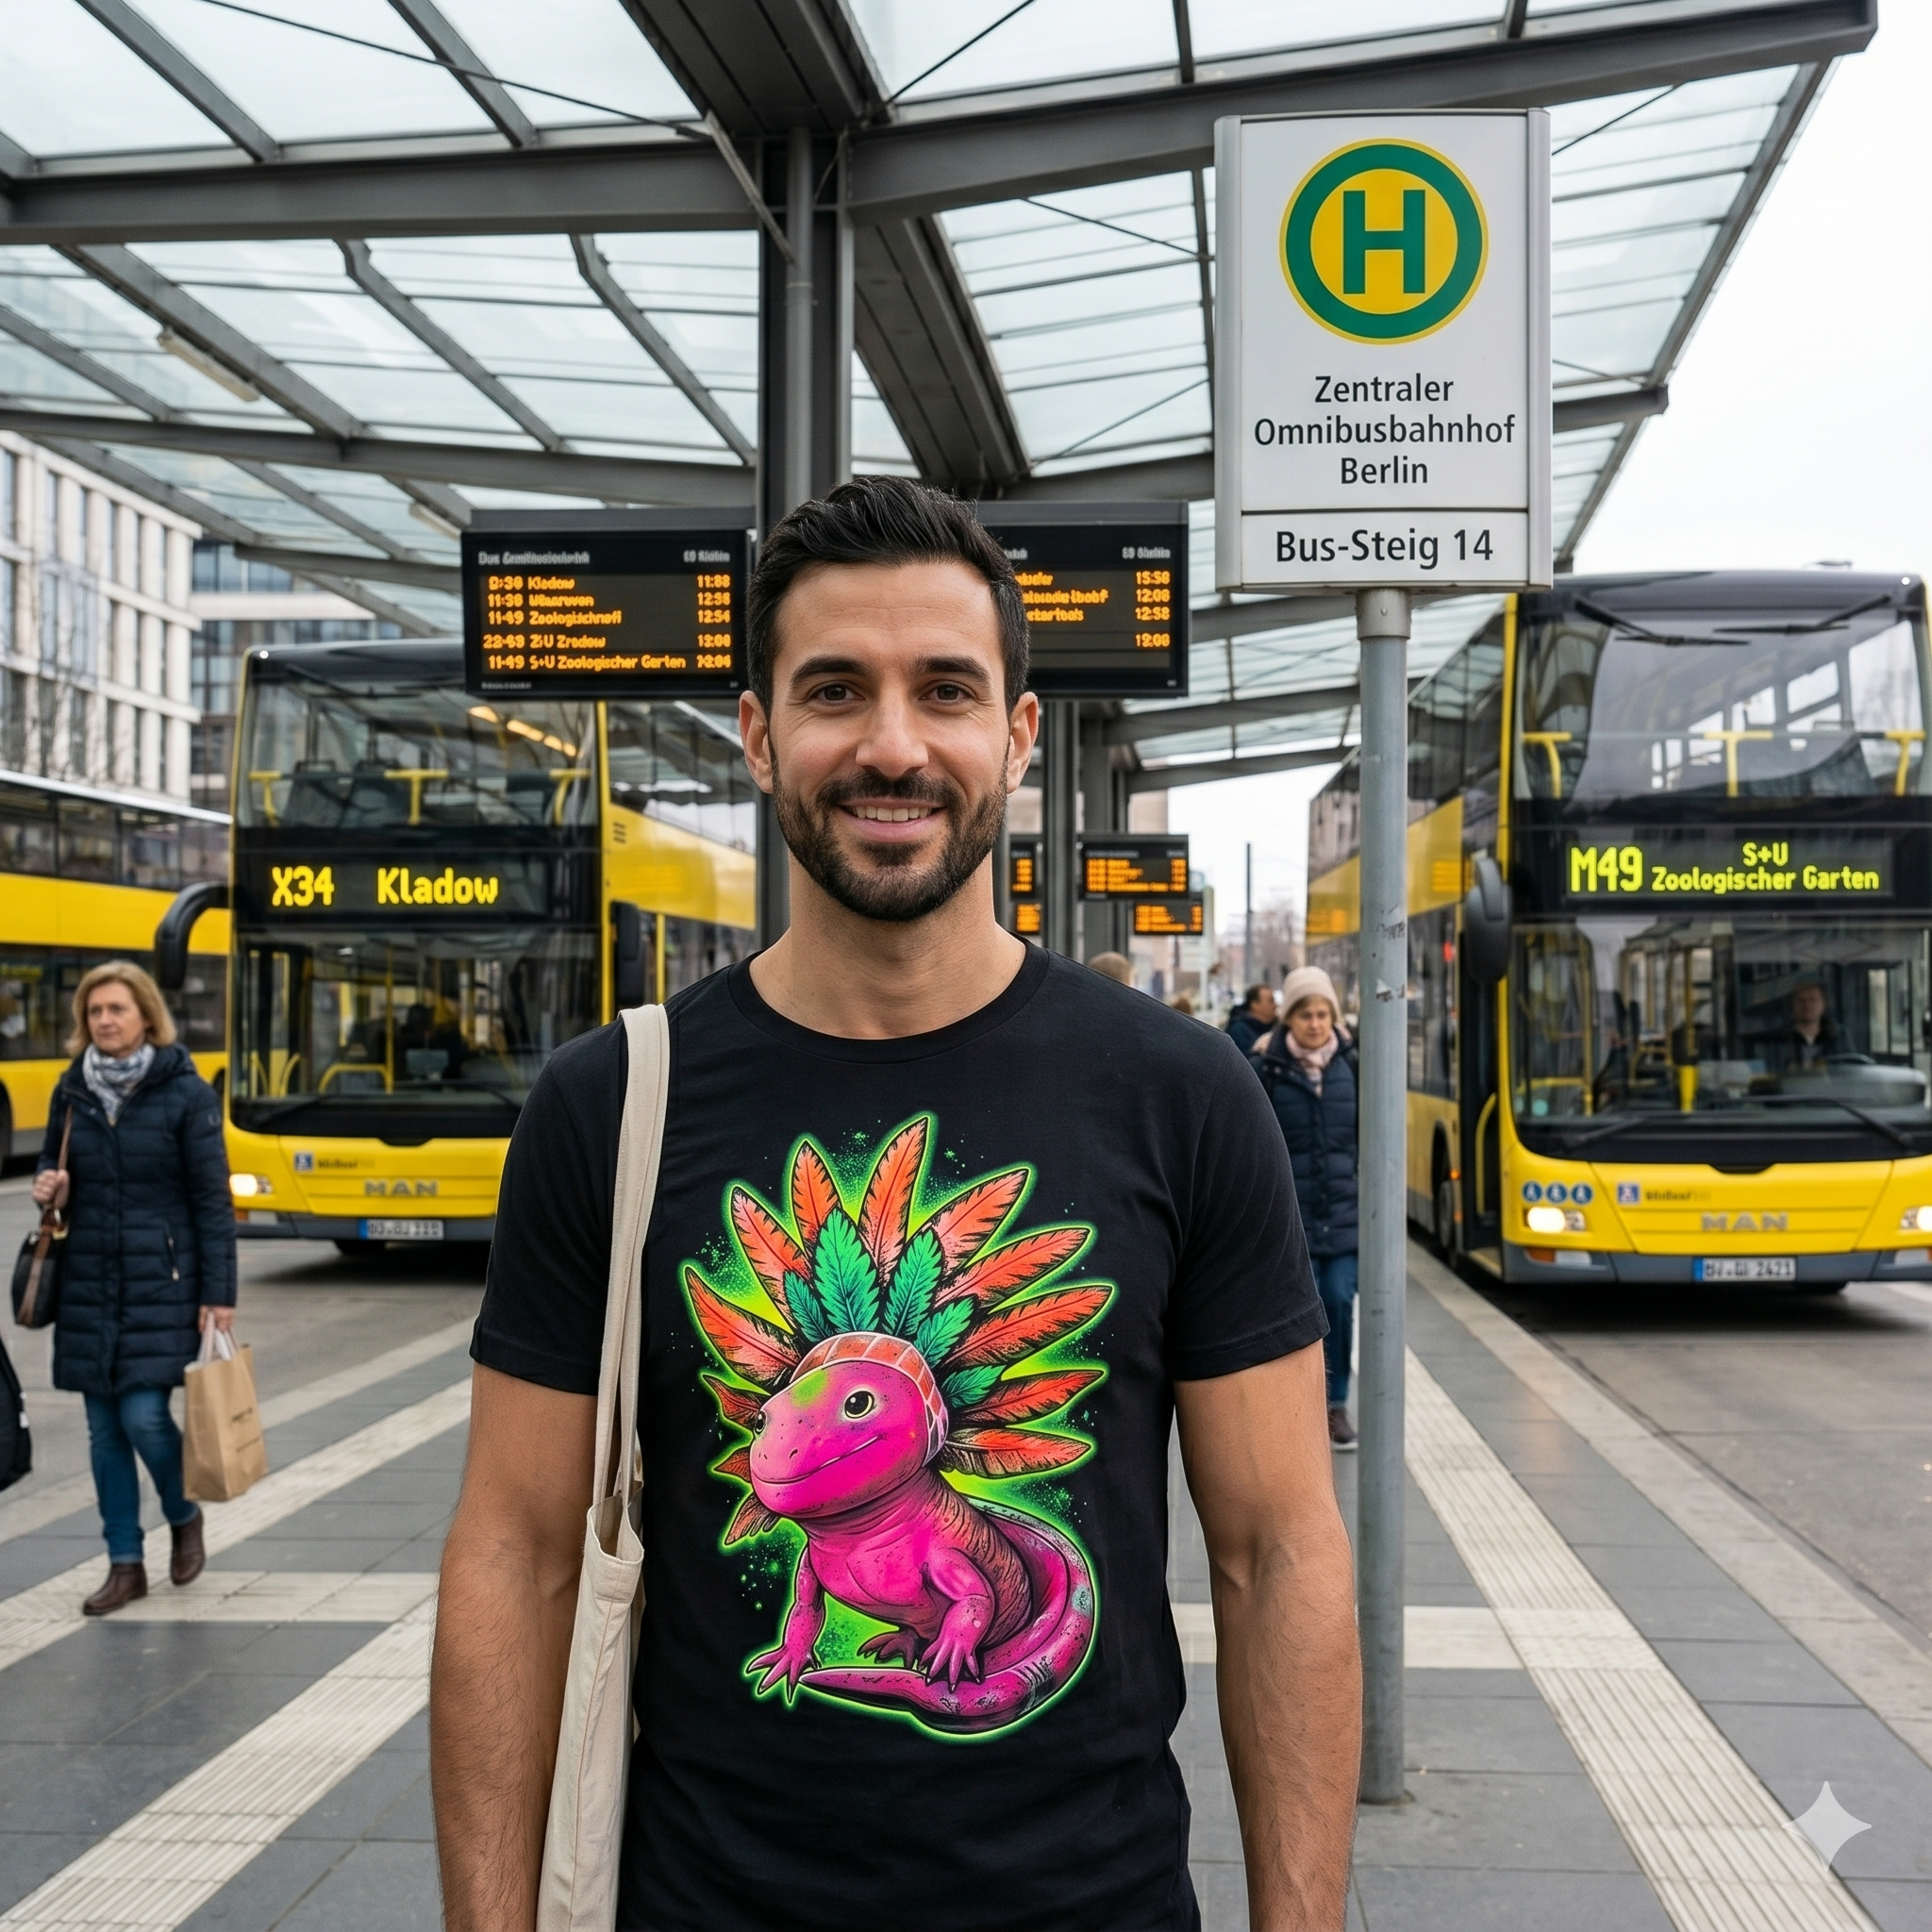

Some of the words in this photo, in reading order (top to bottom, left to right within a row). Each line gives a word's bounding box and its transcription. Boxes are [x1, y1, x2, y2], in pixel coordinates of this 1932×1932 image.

[1342, 189, 1426, 294] H
[1315, 374, 1453, 402] Zentraler
[1256, 414, 1515, 445] Omnibusbahnhof
[1341, 456, 1426, 483] Berlin
[1277, 528, 1438, 569] Bus-Steig
[1455, 530, 1492, 559] 14
[1743, 842, 1788, 866] S+U
[1572, 847, 1642, 891] M49
[1652, 866, 1796, 893] Zoologischer
[1804, 866, 1878, 890] Garten
[273, 866, 334, 906] X34
[378, 868, 498, 904] Kladow
[364, 1180, 438, 1196] MAN
[1701, 1212, 1789, 1231] MAN
